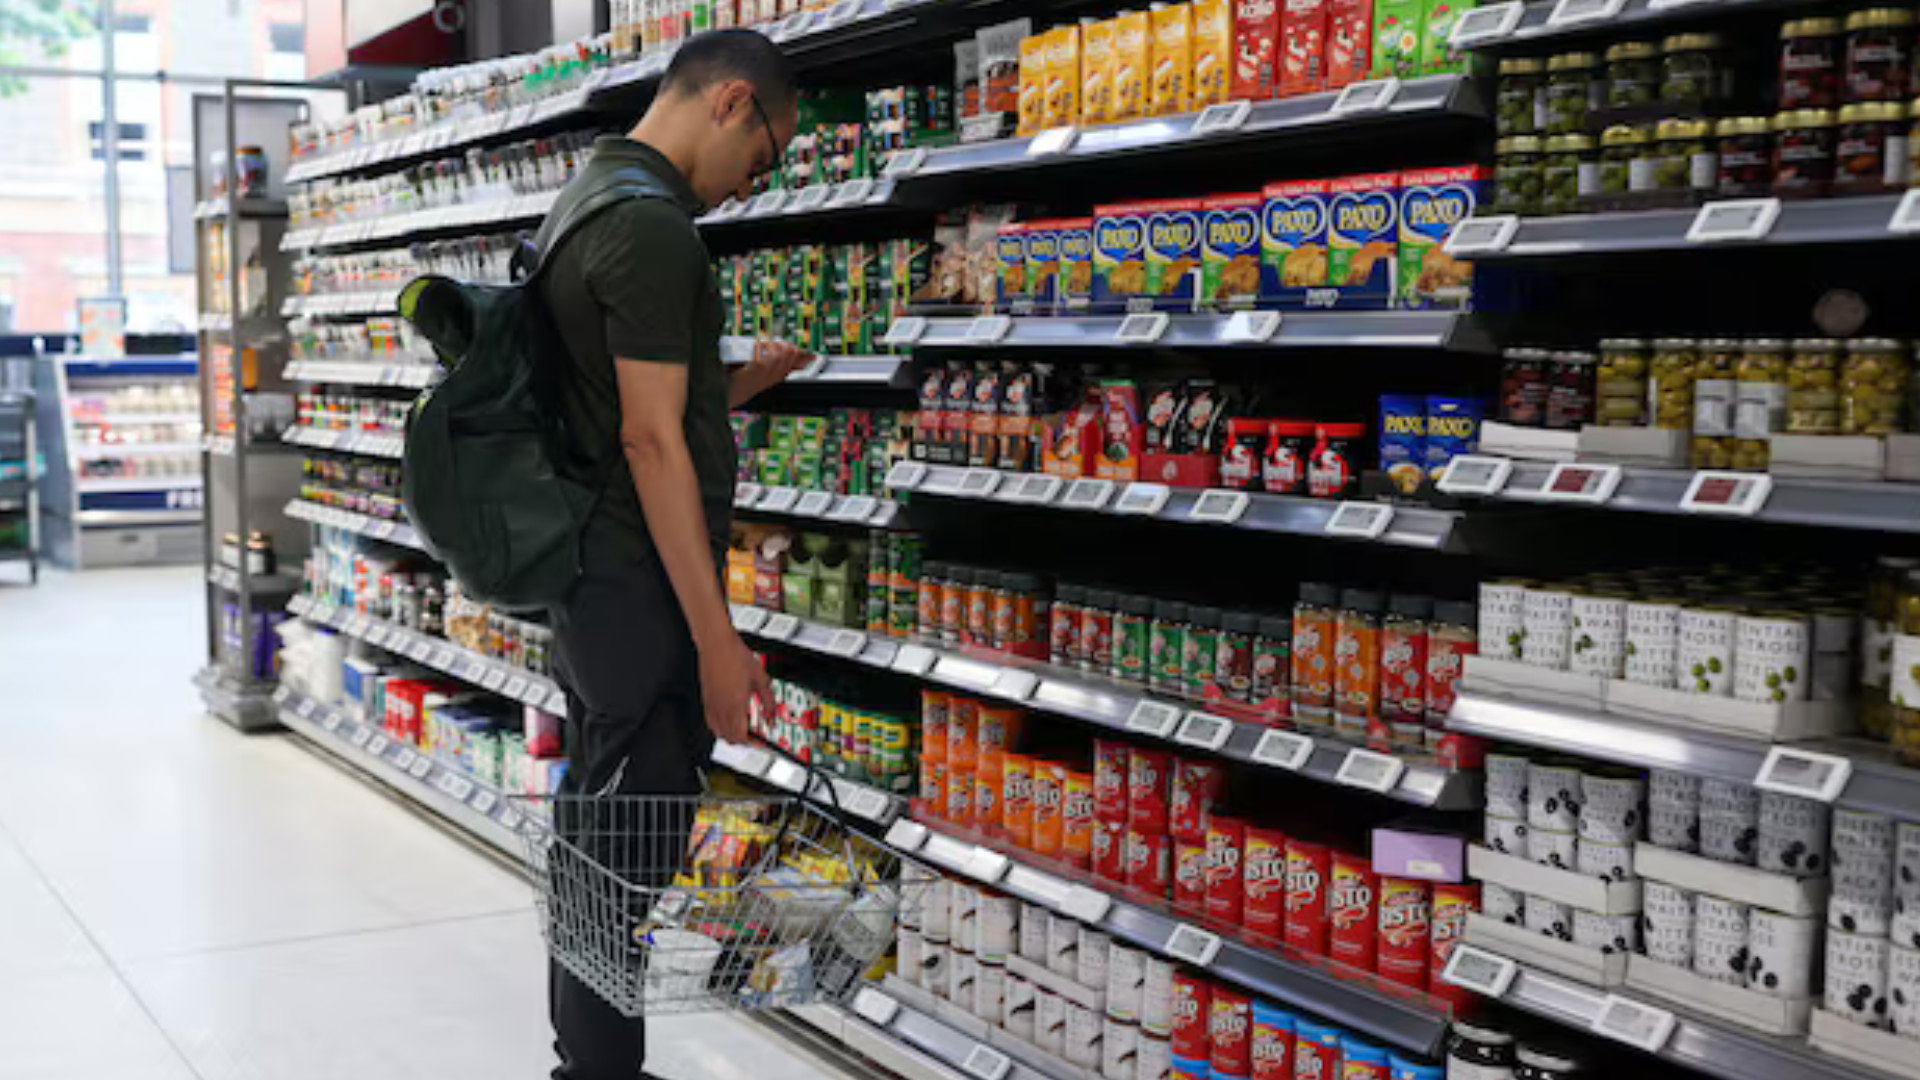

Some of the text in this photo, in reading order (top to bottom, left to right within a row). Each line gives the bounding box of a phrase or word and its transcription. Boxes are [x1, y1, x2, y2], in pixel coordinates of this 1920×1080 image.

[1271, 209, 1318, 236] PAXO
[1338, 204, 1386, 230] PAXO
[1409, 198, 1464, 225] PAXO
[1102, 228, 1139, 250] PAXO
[1152, 223, 1192, 247] PAXO
[1208, 221, 1252, 245] PAXO
[1428, 416, 1474, 437] PAXO
